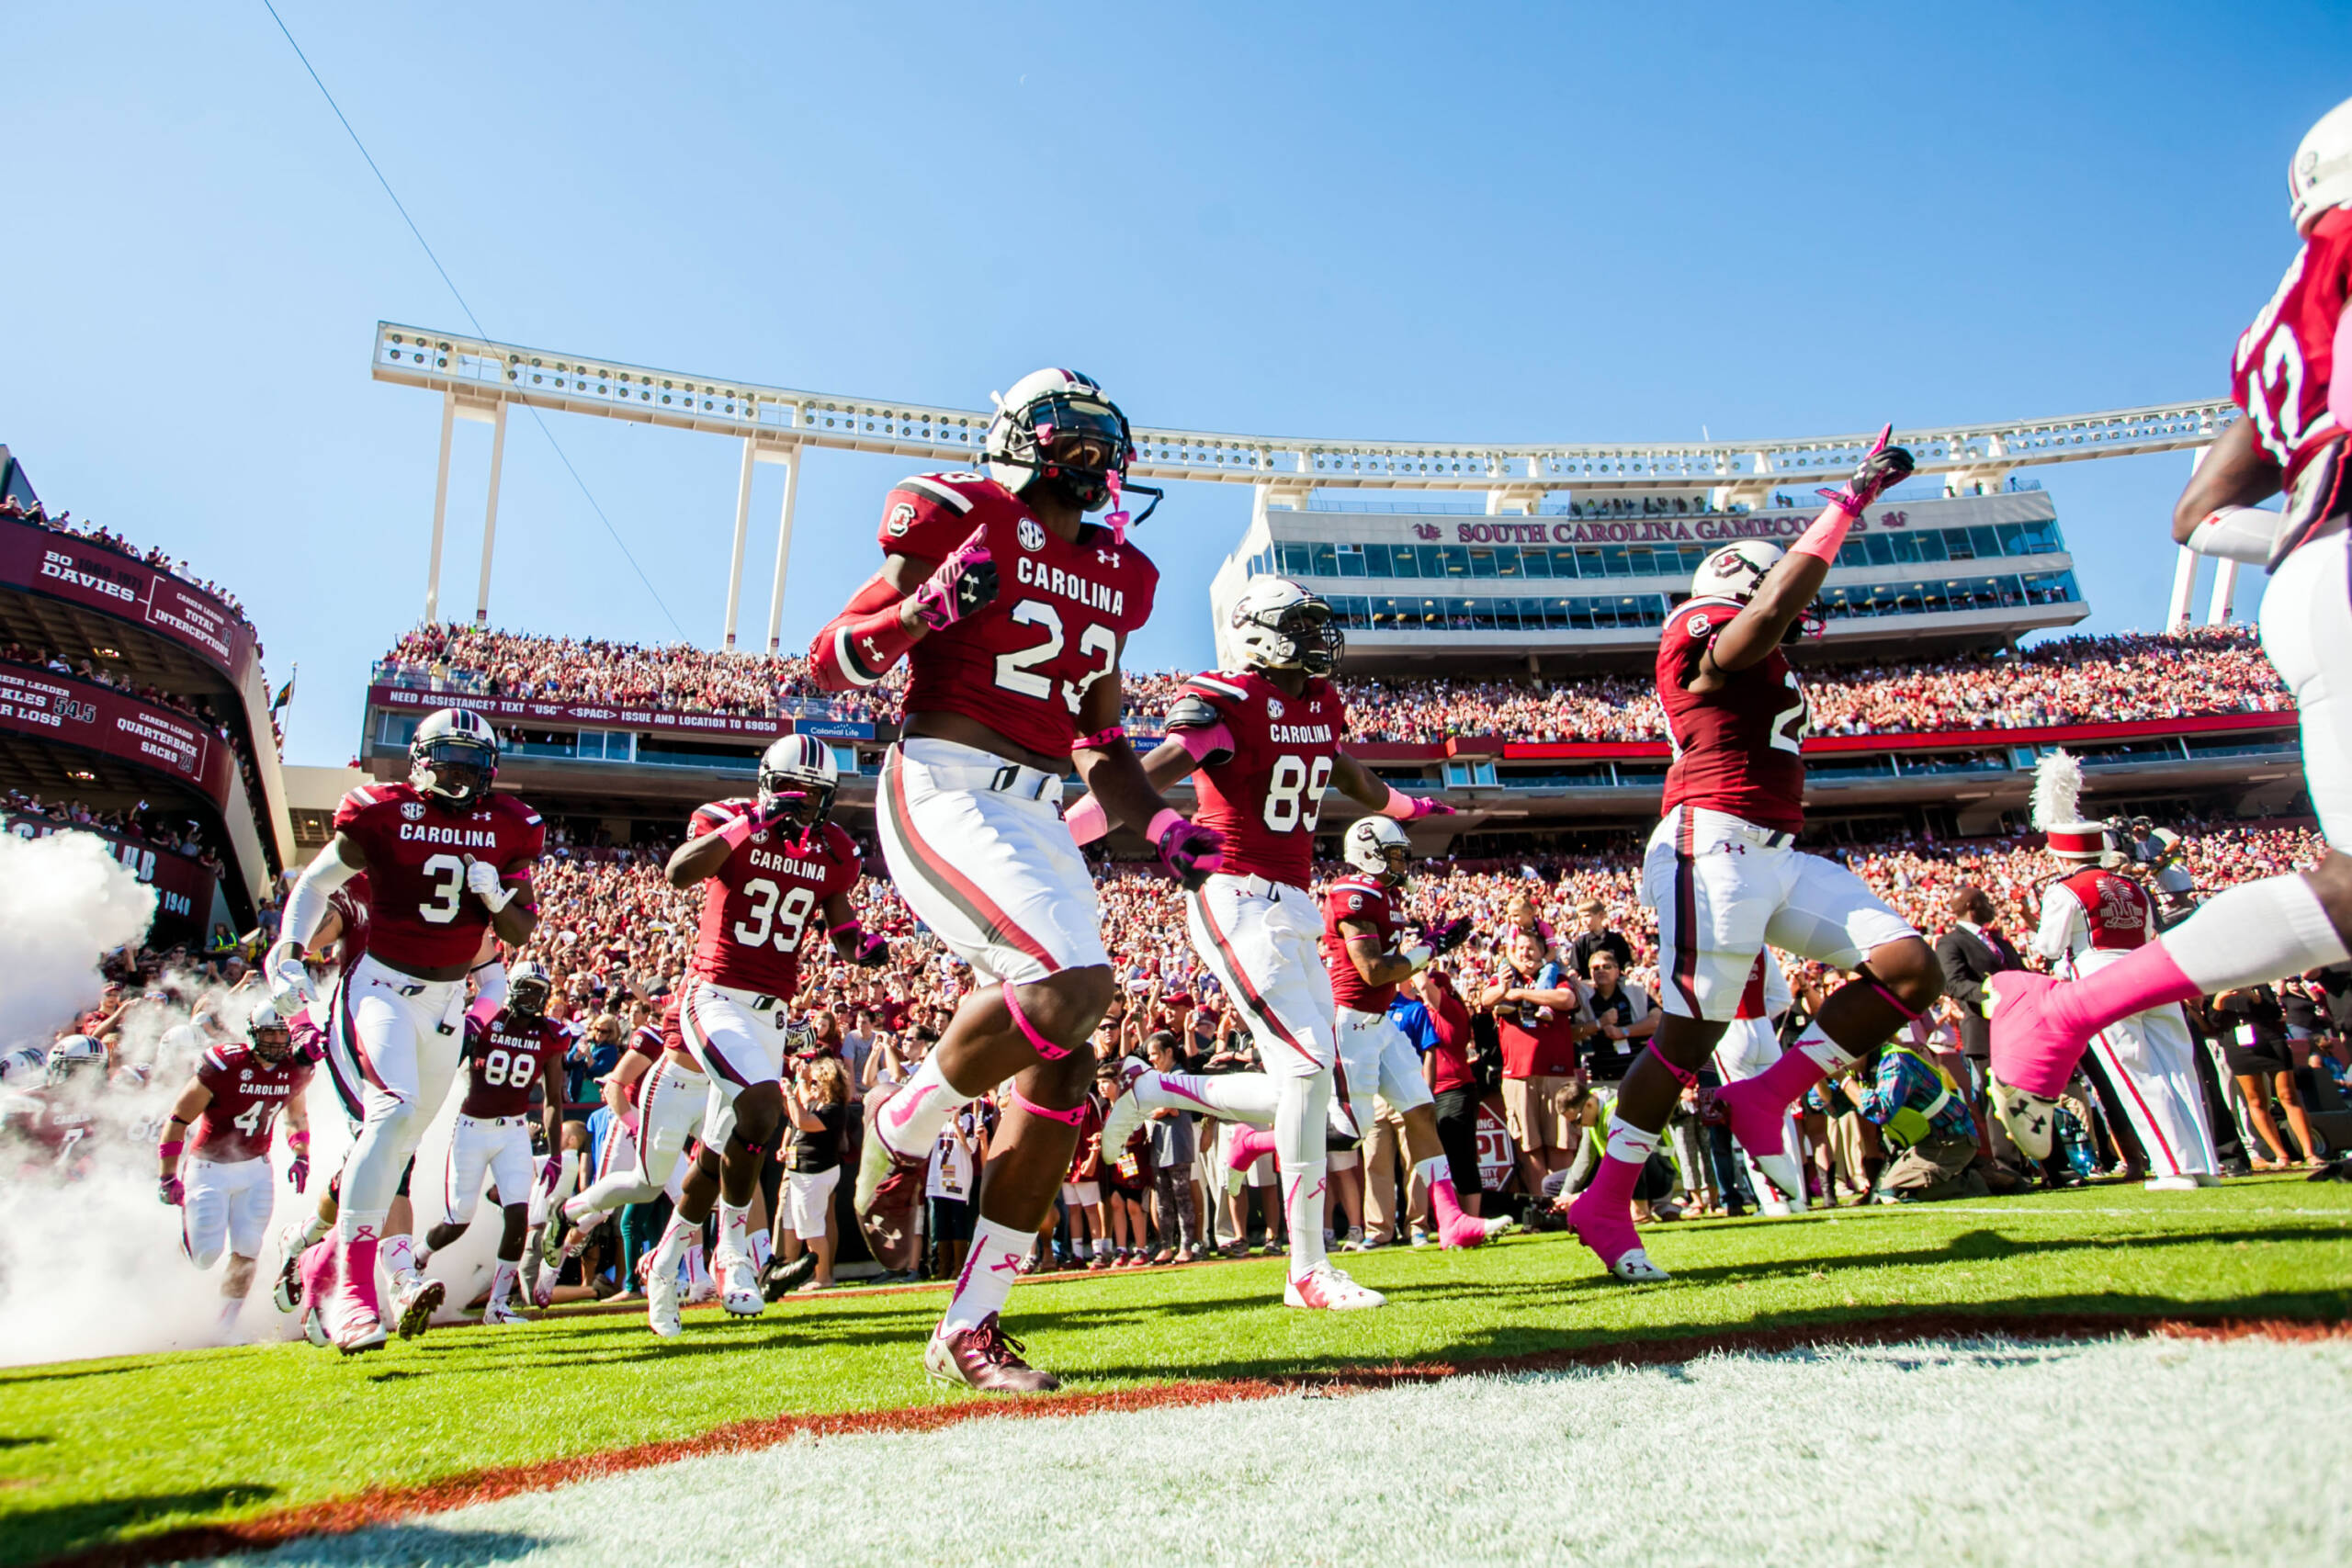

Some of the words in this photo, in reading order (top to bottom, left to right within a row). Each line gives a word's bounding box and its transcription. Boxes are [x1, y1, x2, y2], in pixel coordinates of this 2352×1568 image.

[1019, 519, 1045, 550] SEC
[1457, 523, 1549, 543] SOUTH
[1553, 521, 1691, 543] CAROLINA
[1695, 512, 1868, 540] GAMECOS
[44, 550, 73, 567] BO
[40, 561, 135, 603] DAVIES
[1017, 557, 1123, 616] CAROLINA
[176, 592, 202, 612] CAREER
[203, 606, 224, 626] LEADER
[185, 608, 215, 634] TOTAL
[154, 608, 230, 658] INTERCEPTIONS
[995, 598, 1116, 716] 23
[0, 674, 25, 687] EER
[27, 681, 71, 698] LEADER
[0, 686, 47, 707] KLES
[53, 696, 96, 724] 54.5
[17, 706, 62, 728] LOSS
[390, 692, 418, 704] NEED
[422, 694, 497, 711] ASSISTANCE?
[501, 701, 525, 713] TEXT
[568, 706, 617, 719] <SPACE>
[621, 711, 651, 724] ISSUE
[654, 713, 675, 725] AND
[678, 715, 727, 729] LOCATION
[729, 719, 741, 730] TO
[744, 720, 777, 733] 69050
[117, 717, 198, 758] QUARTERBACK
[139, 712, 169, 730] CAREER
[170, 724, 194, 741] LEADER
[810, 727, 843, 737] Colonial
[844, 728, 860, 738] Life
[1270, 723, 1332, 744] CAROLINA
[141, 740, 178, 763] SACKS
[1263, 755, 1333, 833] 89
[401, 801, 425, 820] SEC
[400, 823, 497, 849] CAROLINA
[750, 848, 826, 883] CAROLINA
[419, 853, 465, 924] 3
[735, 877, 815, 953] 39
[490, 1032, 541, 1051] CAROLINA
[485, 1049, 536, 1088] 88
[239, 1083, 290, 1096] CAROLINA
[233, 1100, 283, 1136] 41
[1476, 1118, 1494, 1130] ING
[55, 1127, 85, 1167] 7
[1479, 1168, 1498, 1179] RITY
[1481, 1178, 1499, 1189] EMS
